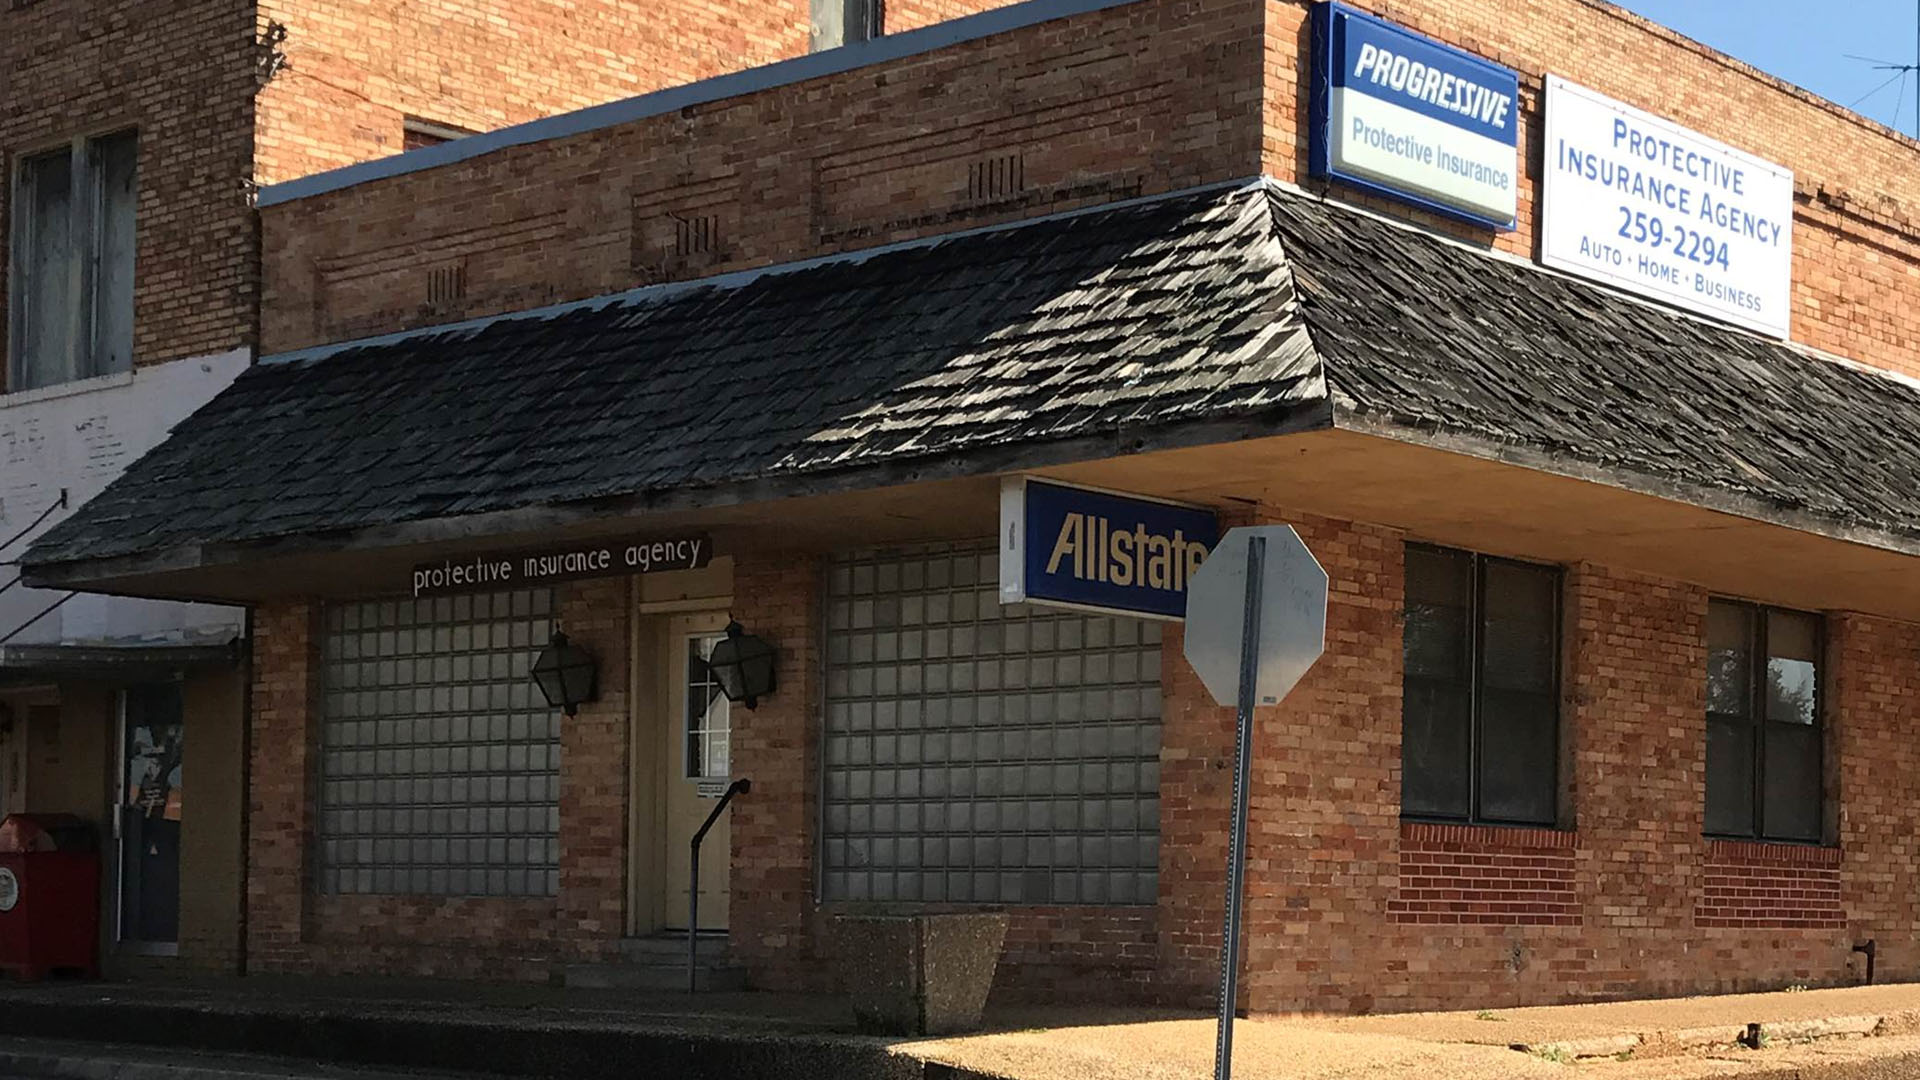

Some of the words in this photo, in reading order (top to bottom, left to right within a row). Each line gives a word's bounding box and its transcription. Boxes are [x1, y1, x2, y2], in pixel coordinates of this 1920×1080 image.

[1353, 42, 1511, 129] PROGRESSIVE
[1352, 115, 1433, 165] Protective
[1436, 144, 1509, 190] Insurance
[1613, 117, 1744, 196] PROTECTIVE
[1558, 138, 1691, 215] INSURANCE
[1699, 192, 1781, 247] AGENCY
[1579, 235, 1622, 266] AUTO
[1638, 253, 1680, 285] HOME
[1694, 272, 1762, 312] BUSINESS
[1617, 206, 1730, 272] 259-2294
[414, 557, 512, 597] protective
[524, 549, 611, 577] insurance
[625, 539, 701, 572] agency
